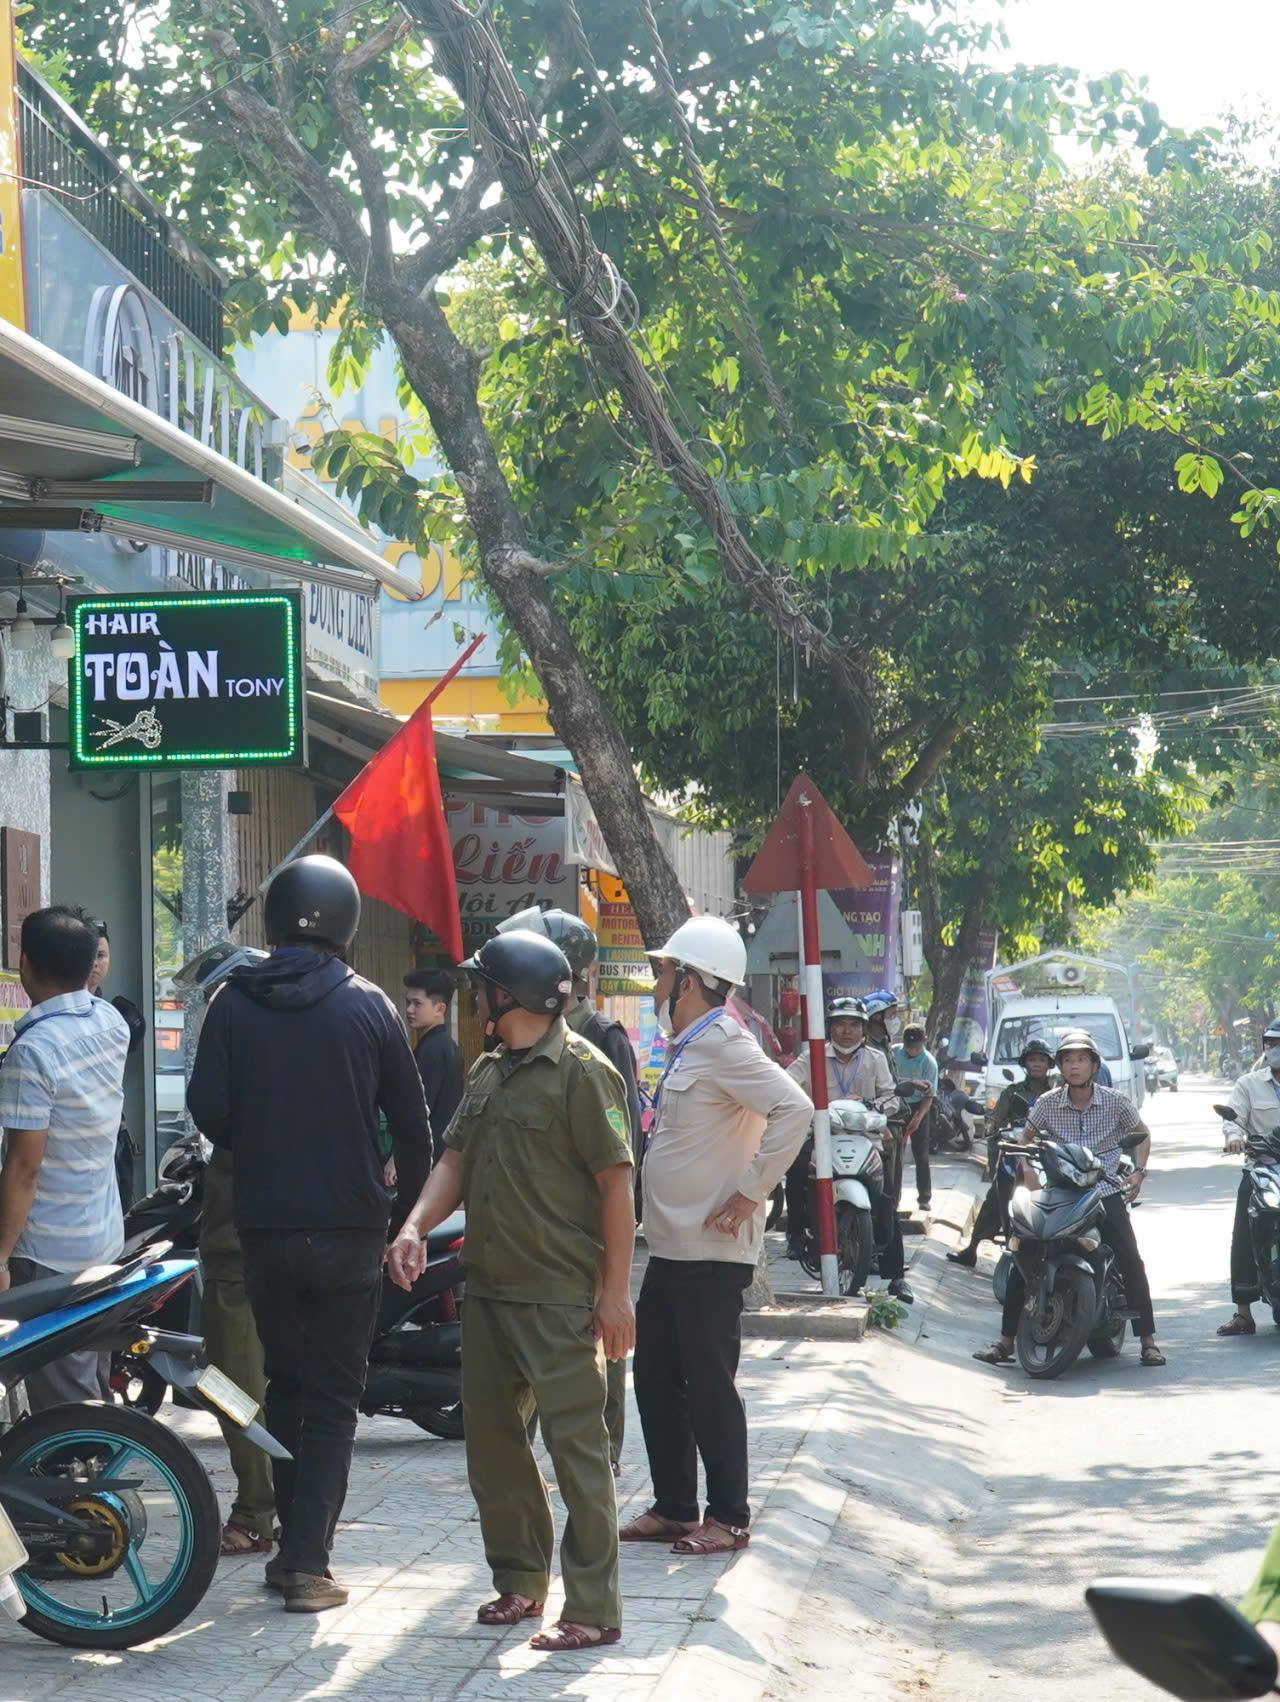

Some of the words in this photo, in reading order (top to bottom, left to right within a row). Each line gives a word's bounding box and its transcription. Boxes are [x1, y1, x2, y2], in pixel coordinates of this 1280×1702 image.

[85, 613, 161, 636] HAIR
[84, 640, 219, 701] TOÀN
[225, 678, 285, 698] TONY
[601, 964, 619, 976] BUS
[623, 964, 650, 977] TICKE
